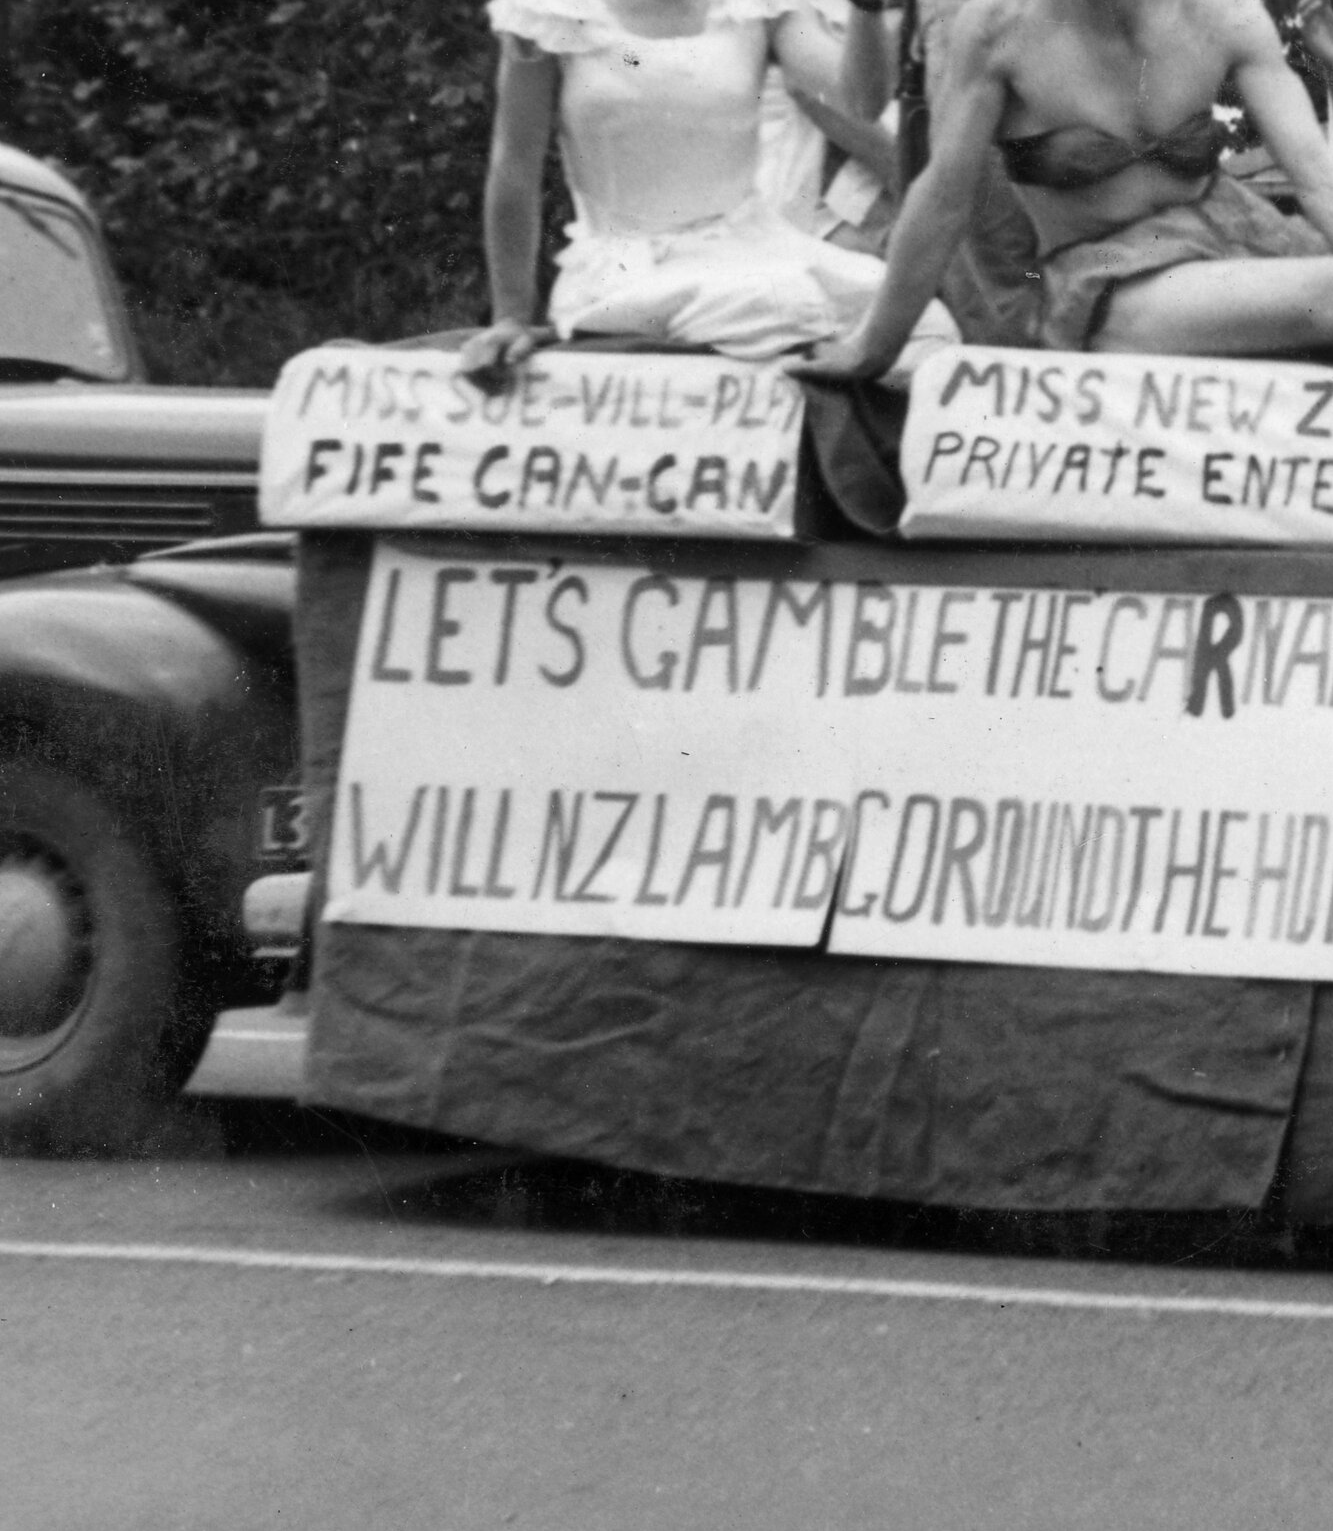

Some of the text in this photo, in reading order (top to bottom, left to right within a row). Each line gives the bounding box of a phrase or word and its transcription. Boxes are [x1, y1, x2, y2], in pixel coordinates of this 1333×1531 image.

[297, 365, 433, 422] MISS
[939, 359, 1106, 426] MISS
[1134, 370, 1276, 436] NEW
[304, 438, 788, 514] FIFE CAN-CAN
[371, 556, 588, 687] LET'S
[621, 572, 977, 698] GAMBLE
[351, 782, 515, 899] WILL
[633, 792, 854, 912] LAMB
